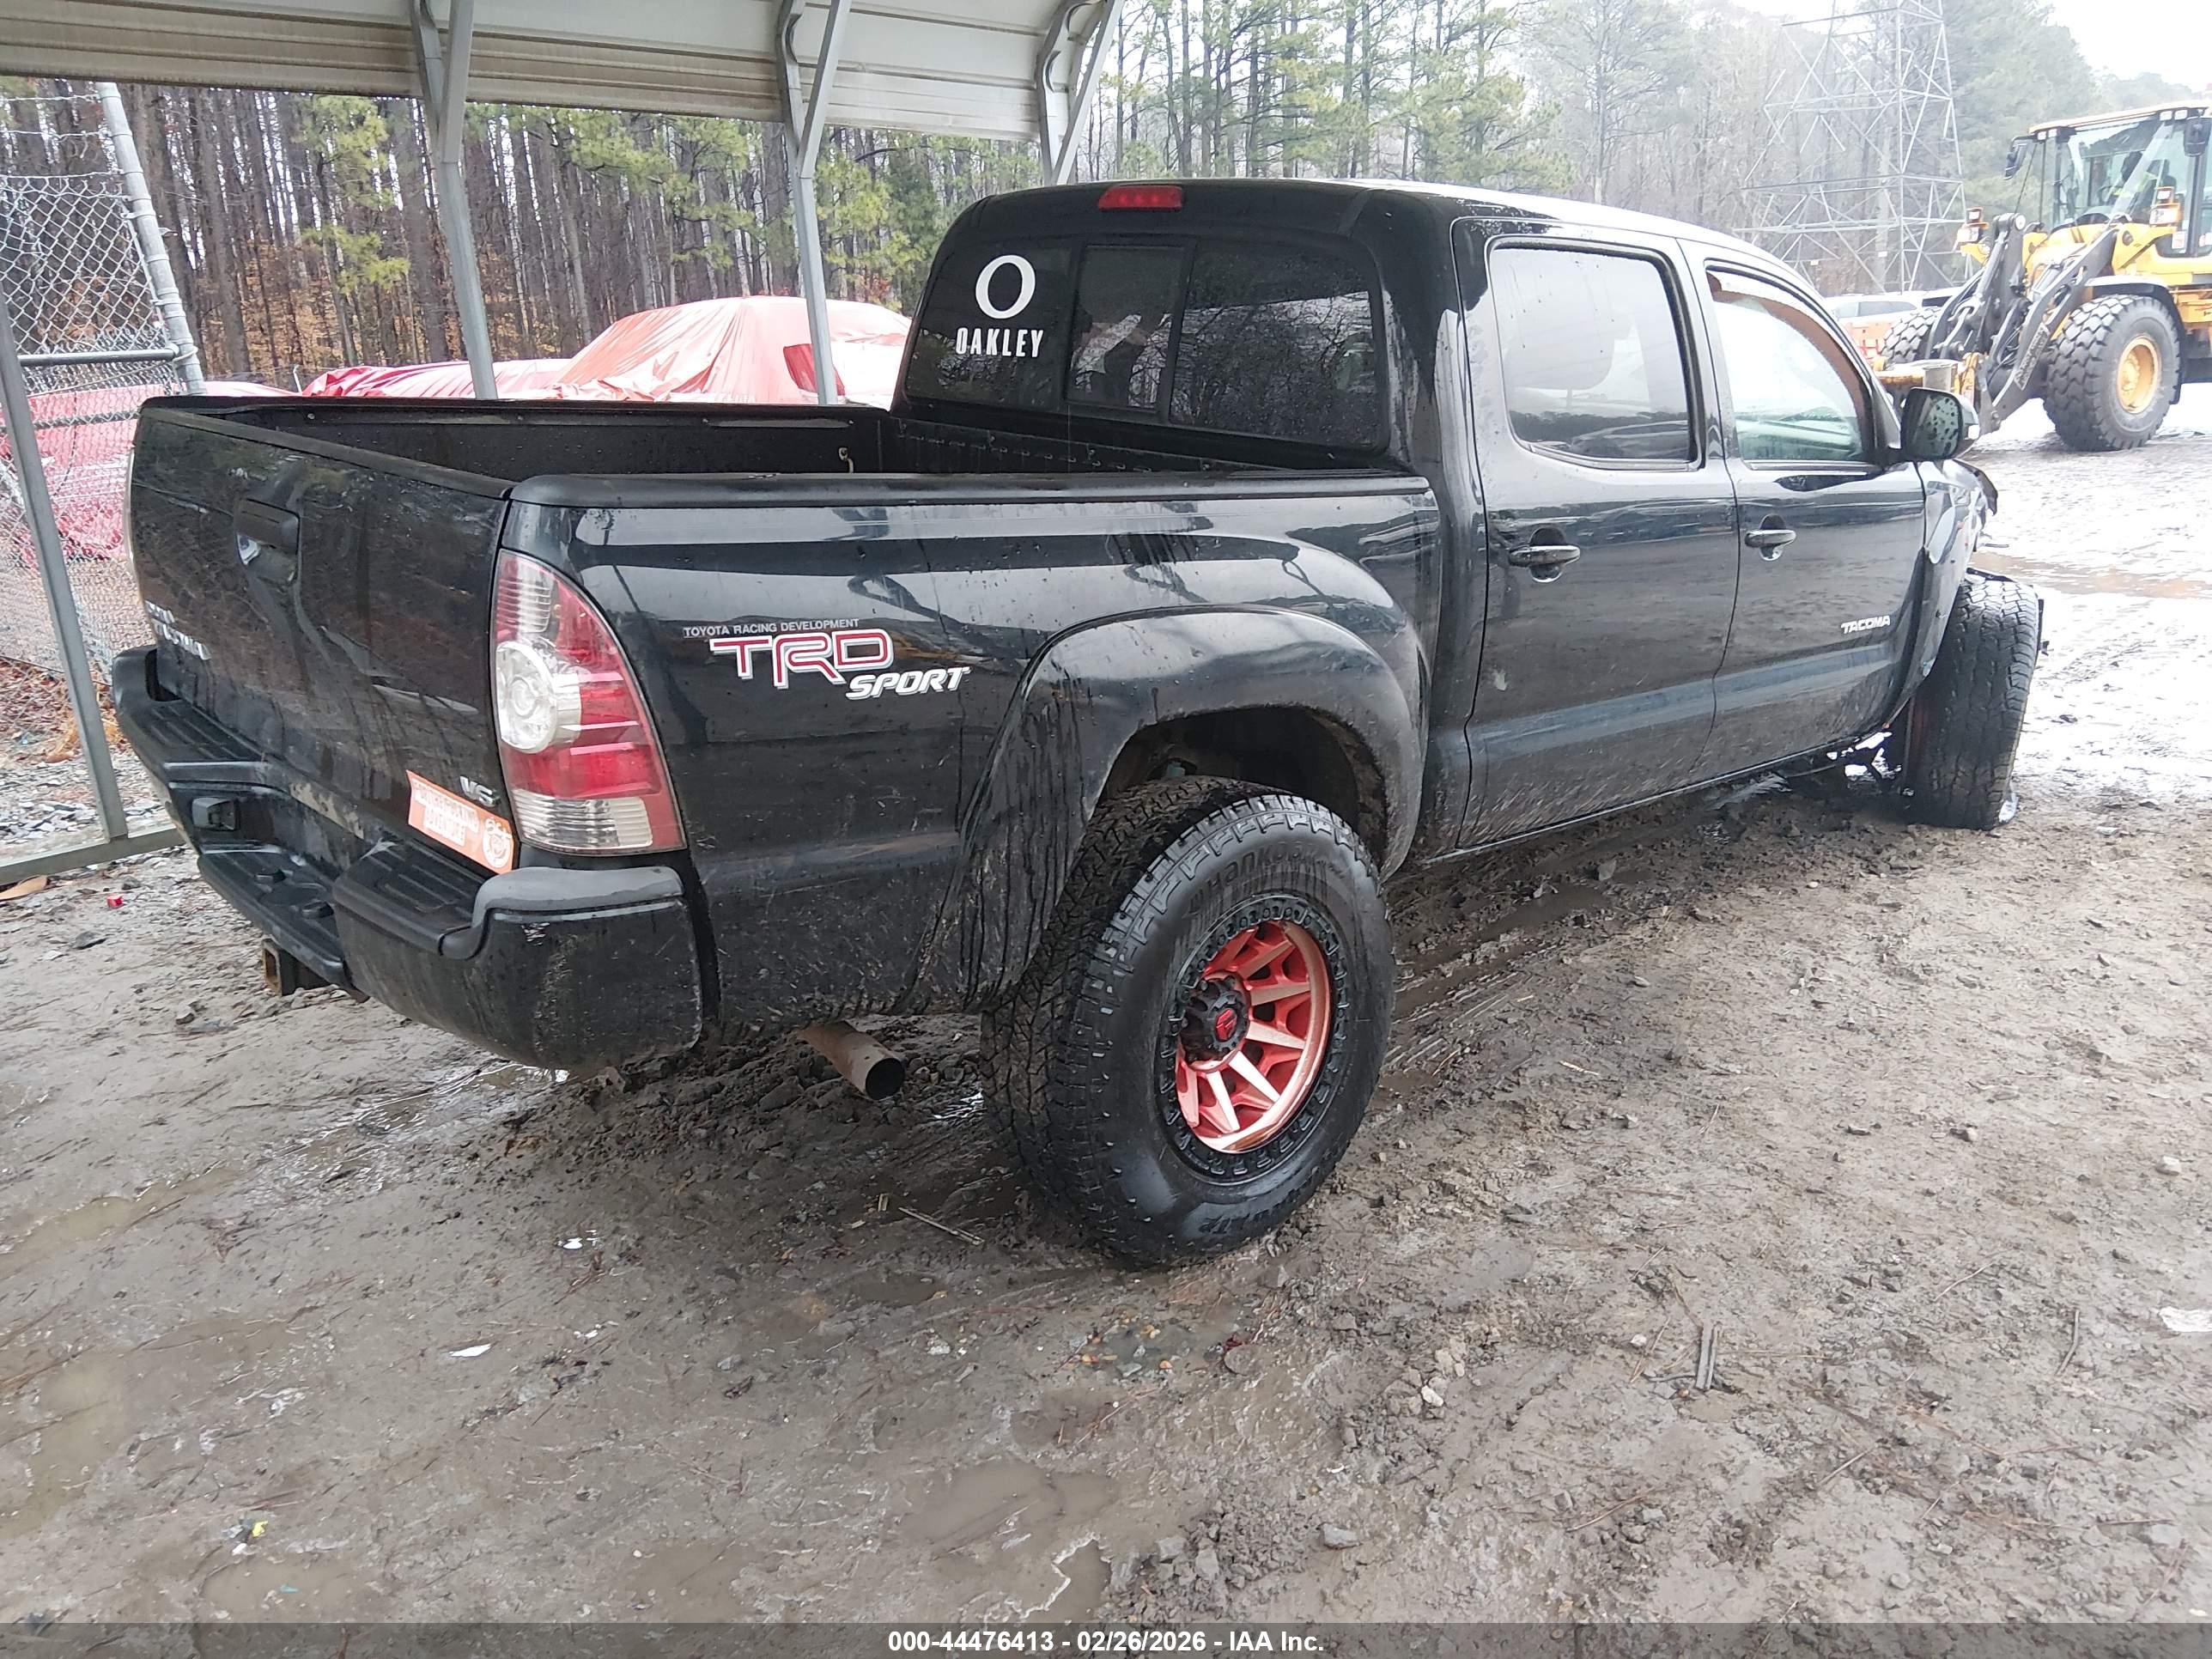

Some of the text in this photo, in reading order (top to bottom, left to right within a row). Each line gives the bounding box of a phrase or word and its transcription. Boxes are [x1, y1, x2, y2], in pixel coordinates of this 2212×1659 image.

[956, 327, 1043, 357] OAKLEY
[684, 618, 860, 638] TOYOTA RACING DEVELOPMENT
[1840, 615, 1891, 635] TACOMA
[709, 629, 894, 690] TRD
[845, 666, 971, 701] SPORT
[459, 775, 501, 807] V6
